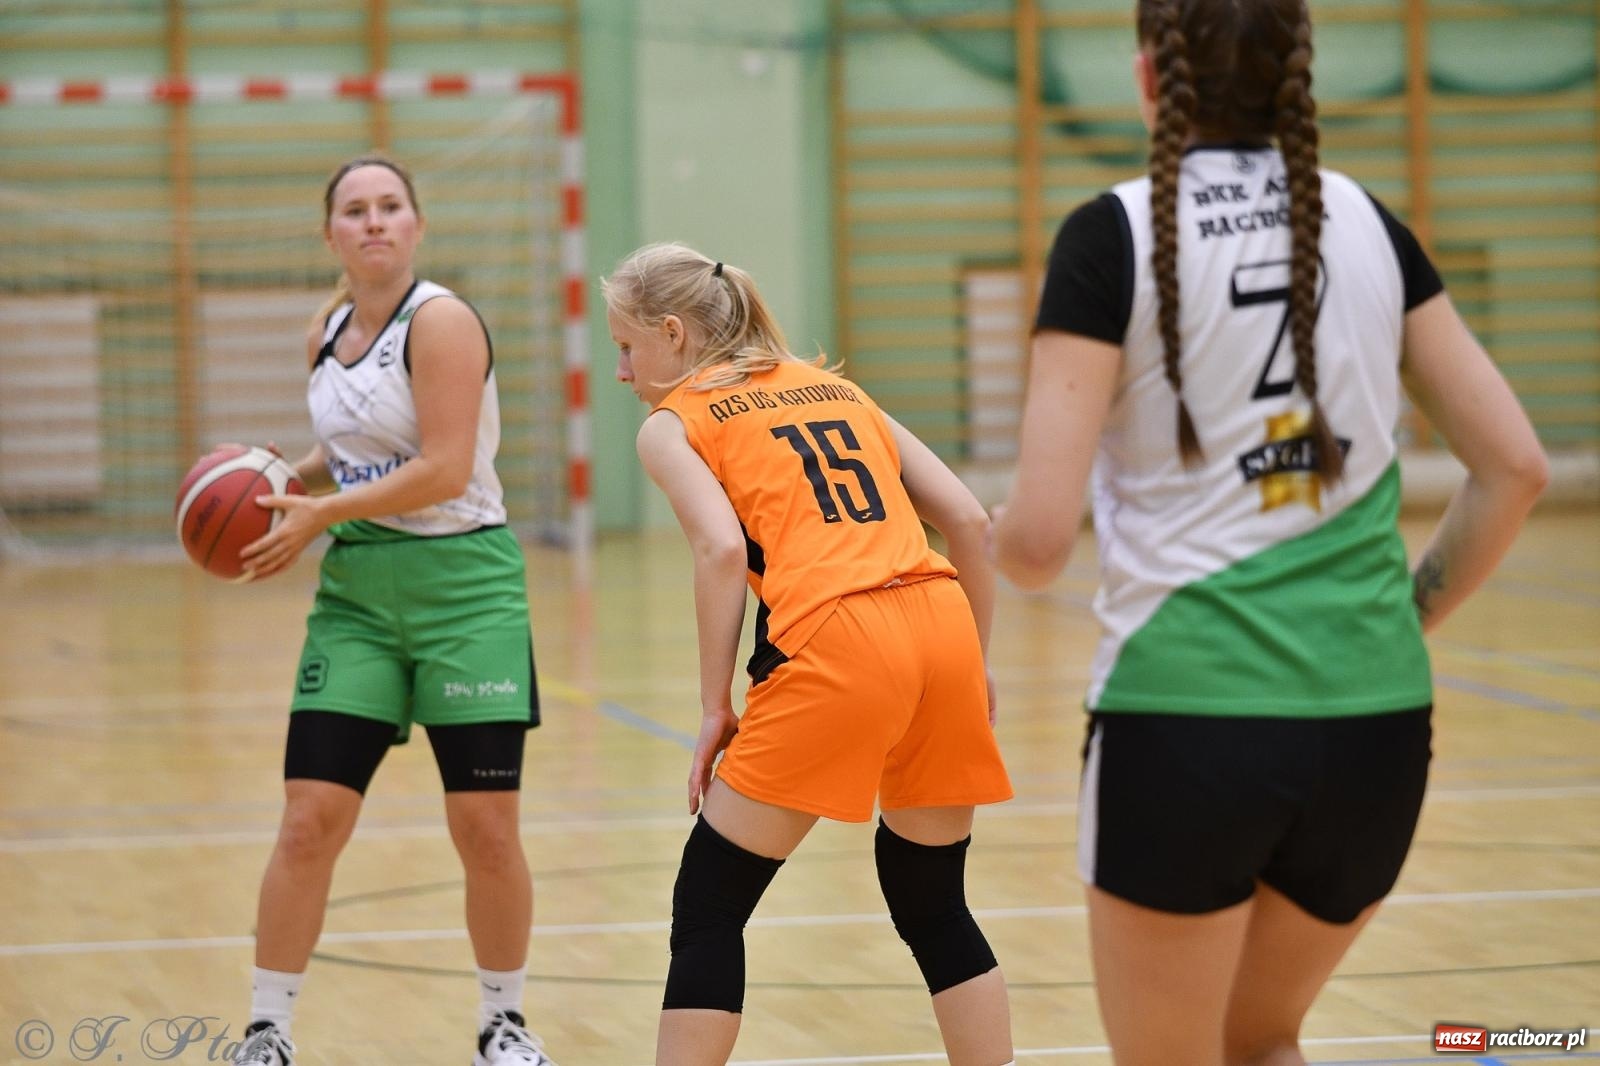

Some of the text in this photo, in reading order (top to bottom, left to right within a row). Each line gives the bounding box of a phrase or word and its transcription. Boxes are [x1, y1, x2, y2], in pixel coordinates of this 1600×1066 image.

[709, 395, 750, 424] AZS
[751, 388, 778, 409] UŚ
[769, 419, 887, 524] 15
